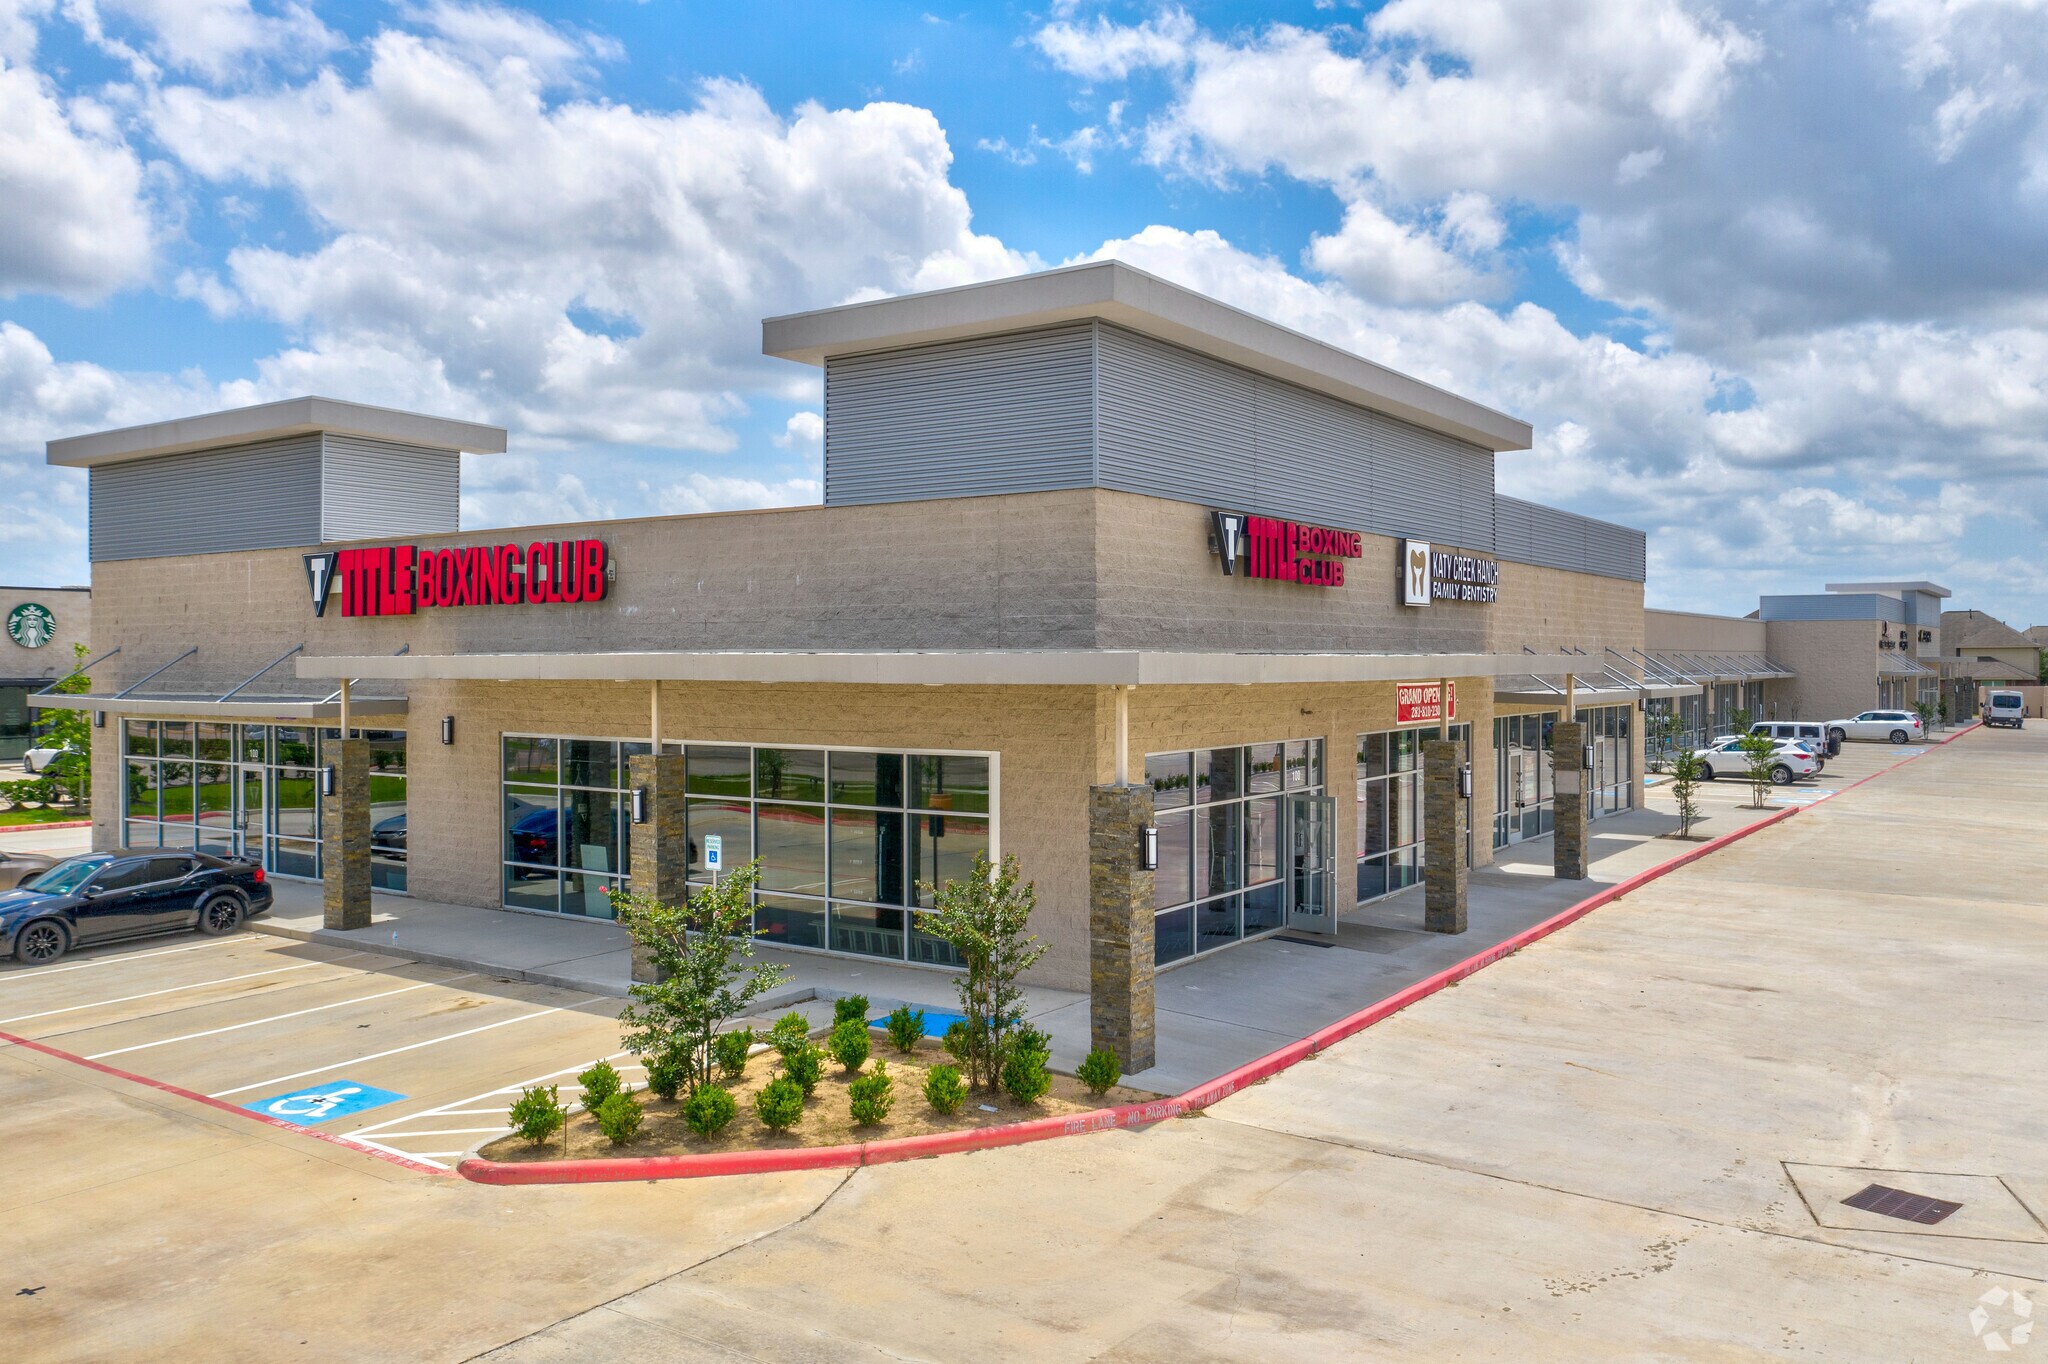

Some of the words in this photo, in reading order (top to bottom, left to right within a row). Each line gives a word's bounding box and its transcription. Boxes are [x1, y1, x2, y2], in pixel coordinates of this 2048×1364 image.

[1248, 515, 1297, 581] TITLE
[1300, 525, 1362, 558] BOXING
[338, 545, 416, 617] TITLE
[417, 543, 522, 608] BOXING
[526, 539, 606, 604] CLUB
[1300, 558, 1345, 587] CLUB
[1433, 552, 1452, 579] KATY
[1453, 556, 1476, 582] CREEK
[1477, 559, 1499, 585] RANCH
[1433, 581, 1460, 600] FAMILY
[1462, 584, 1498, 603] DENTISTRY
[1399, 688, 1422, 705] GRAND
[1423, 686, 1453, 704] OPENG!
[1064, 1119, 1086, 1134] FIRE
[1091, 1114, 1116, 1130] LANE
[1127, 1111, 1140, 1125] NO
[1145, 1103, 1182, 1120] PARKING
